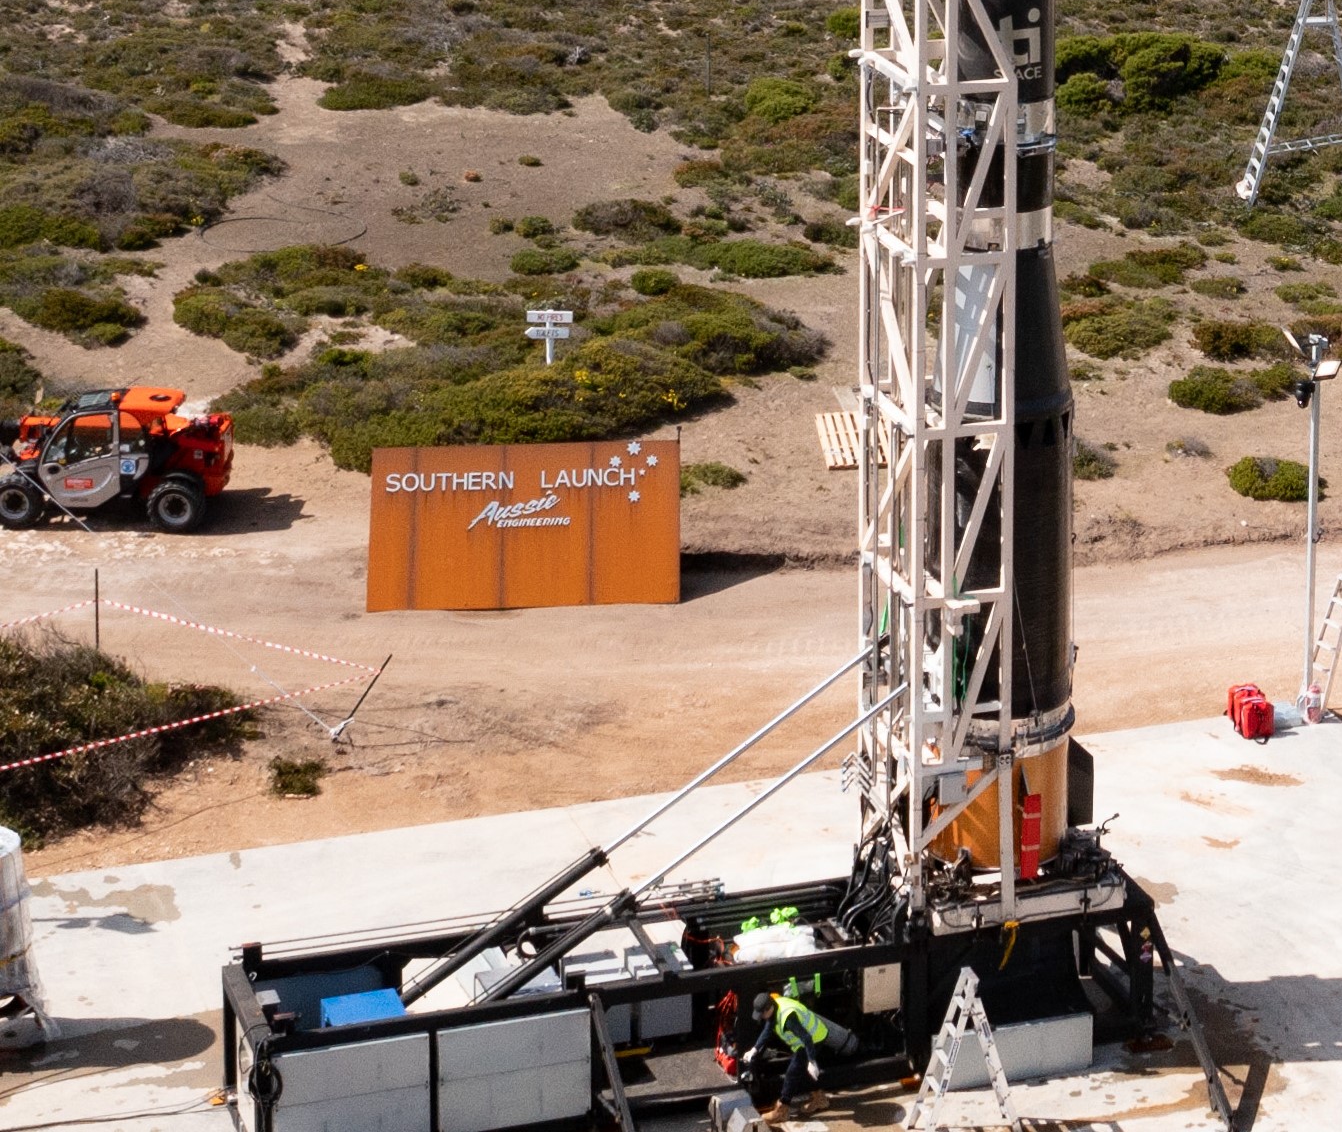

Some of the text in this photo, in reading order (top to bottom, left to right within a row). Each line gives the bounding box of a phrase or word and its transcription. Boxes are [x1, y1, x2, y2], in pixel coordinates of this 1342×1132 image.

[993, 66, 1042, 80] SACE
[385, 468, 636, 493] SOUTHERN LAUNCH
[467, 491, 561, 530] Aussie
[496, 516, 571, 528] ENGINEERING
